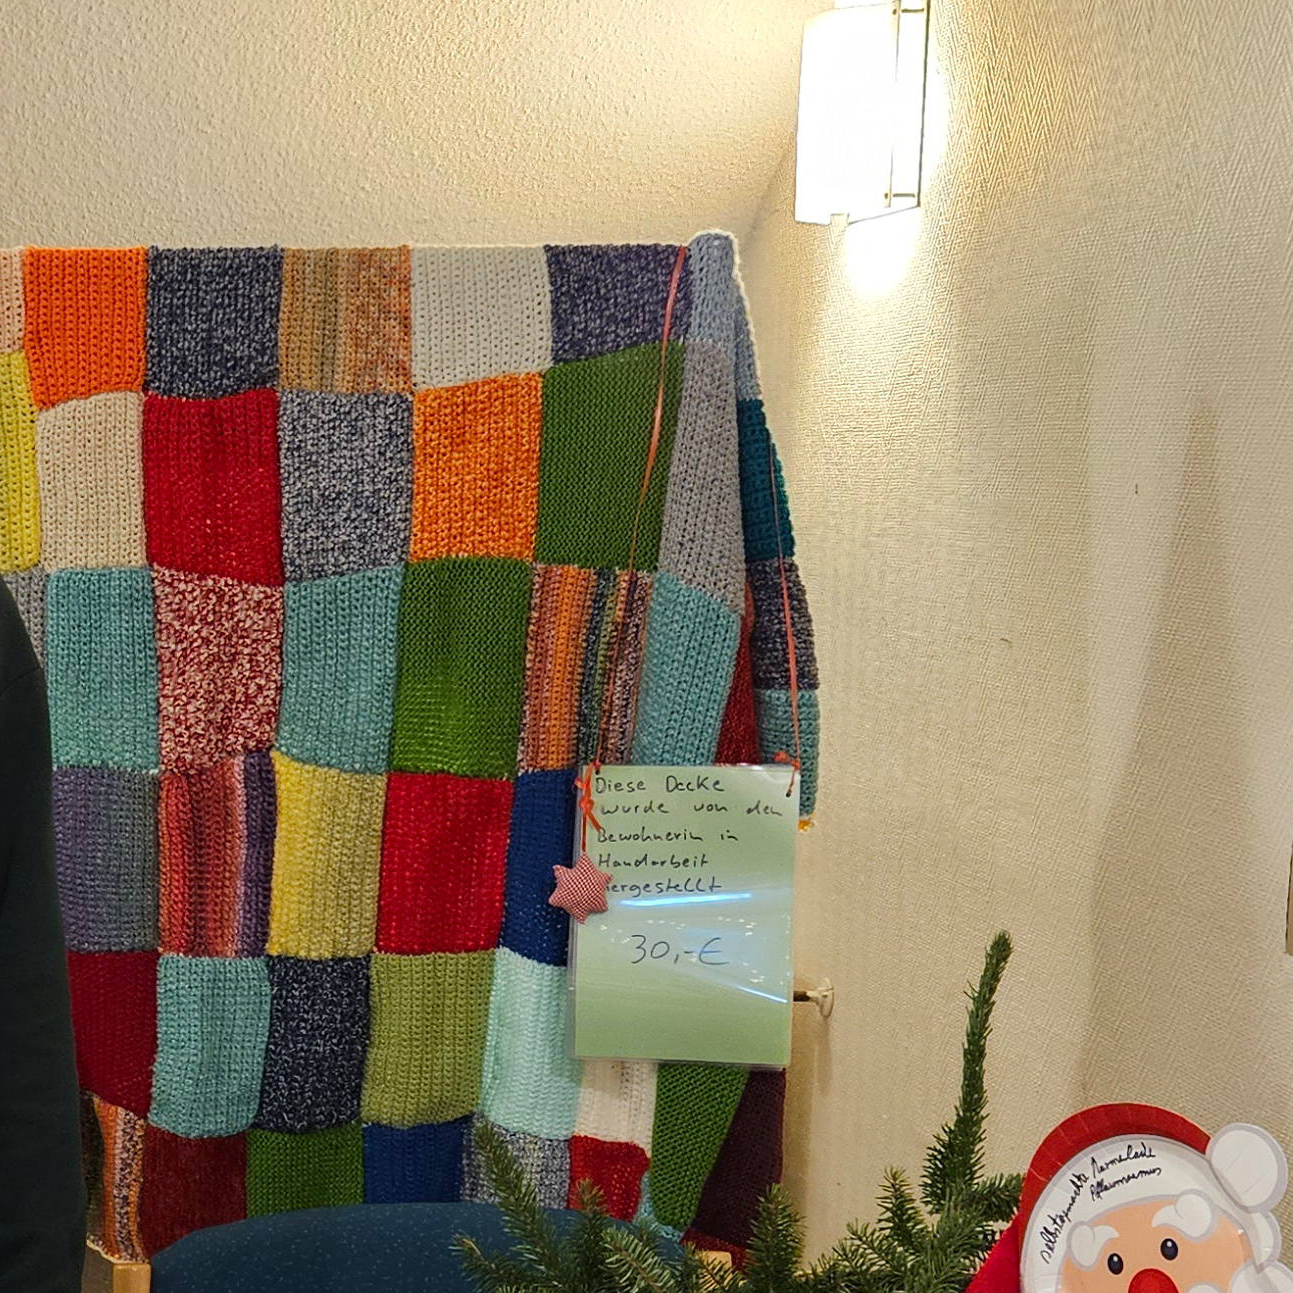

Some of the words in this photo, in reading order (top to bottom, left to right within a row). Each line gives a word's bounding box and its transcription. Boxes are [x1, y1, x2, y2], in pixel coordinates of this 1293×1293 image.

[594, 776, 646, 794] Diese
[600, 800, 669, 815] wurde
[693, 801, 728, 813] von
[720, 829, 739, 841] in
[598, 854, 709, 868] Handarbeit
